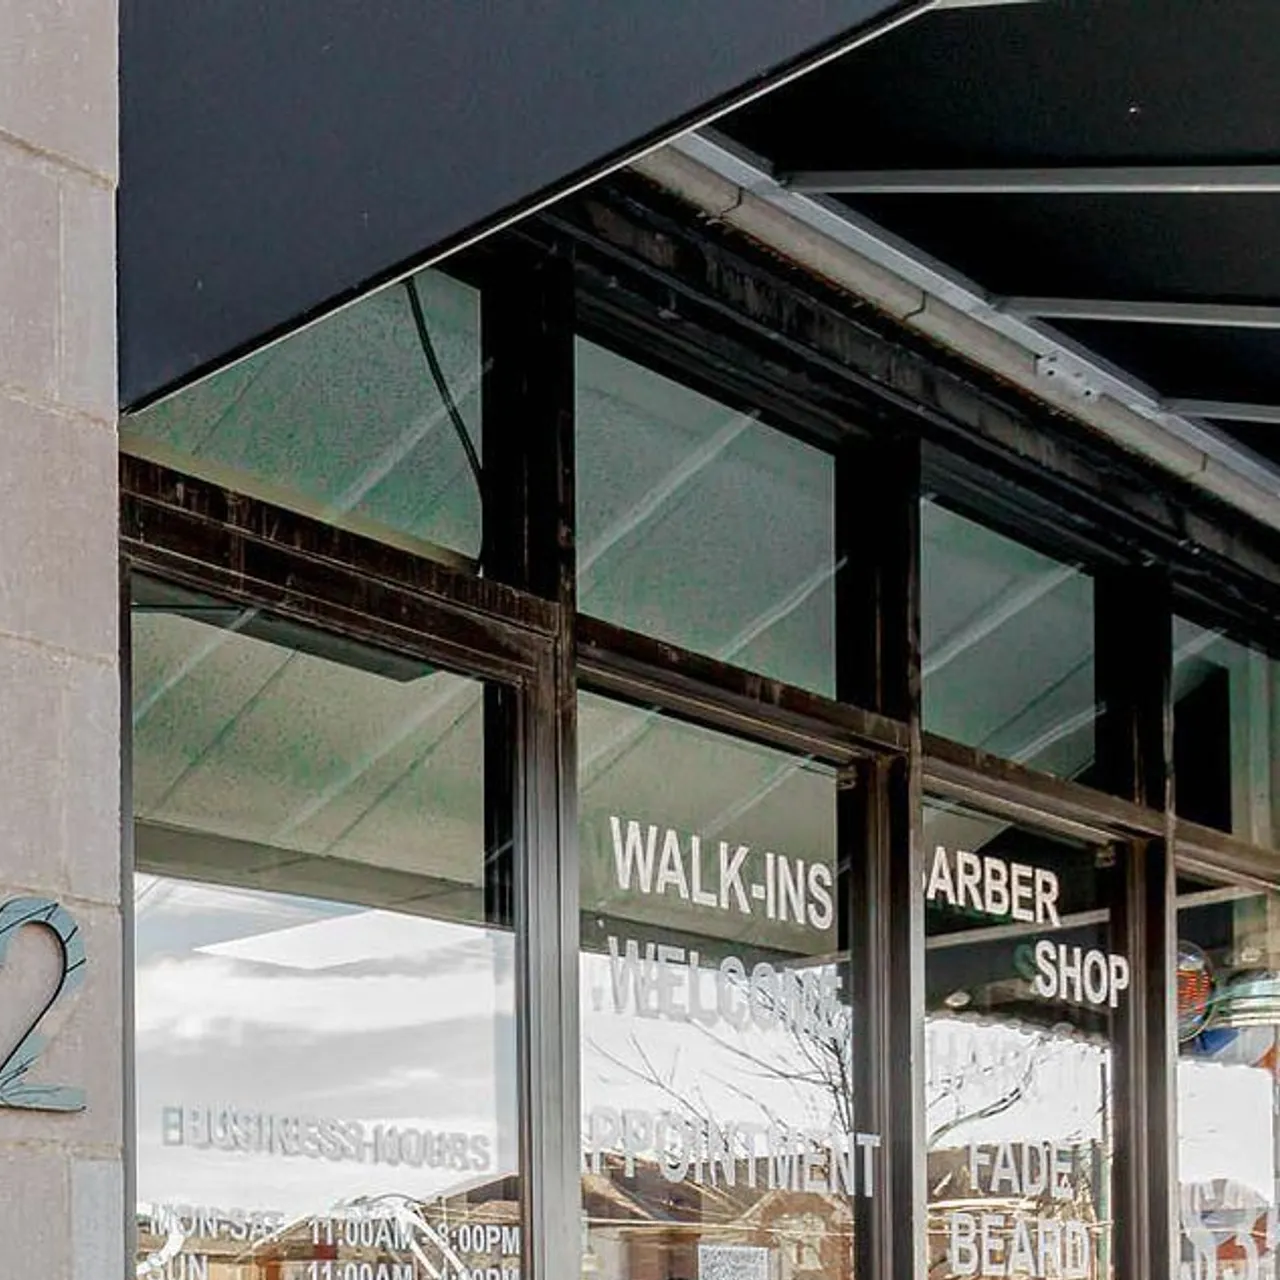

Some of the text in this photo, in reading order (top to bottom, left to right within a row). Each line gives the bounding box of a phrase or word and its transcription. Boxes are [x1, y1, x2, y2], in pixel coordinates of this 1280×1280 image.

[609, 816, 834, 930] WALK-INS
[923, 846, 1062, 927] ARBER
[1034, 940, 1130, 1008] SHOP
[581, 1108, 881, 1198] PPOINTMENT
[969, 1142, 1073, 1200] FADE
[308, 1215, 413, 1250] 11:00AM
[950, 1212, 1089, 1280] BEARD
